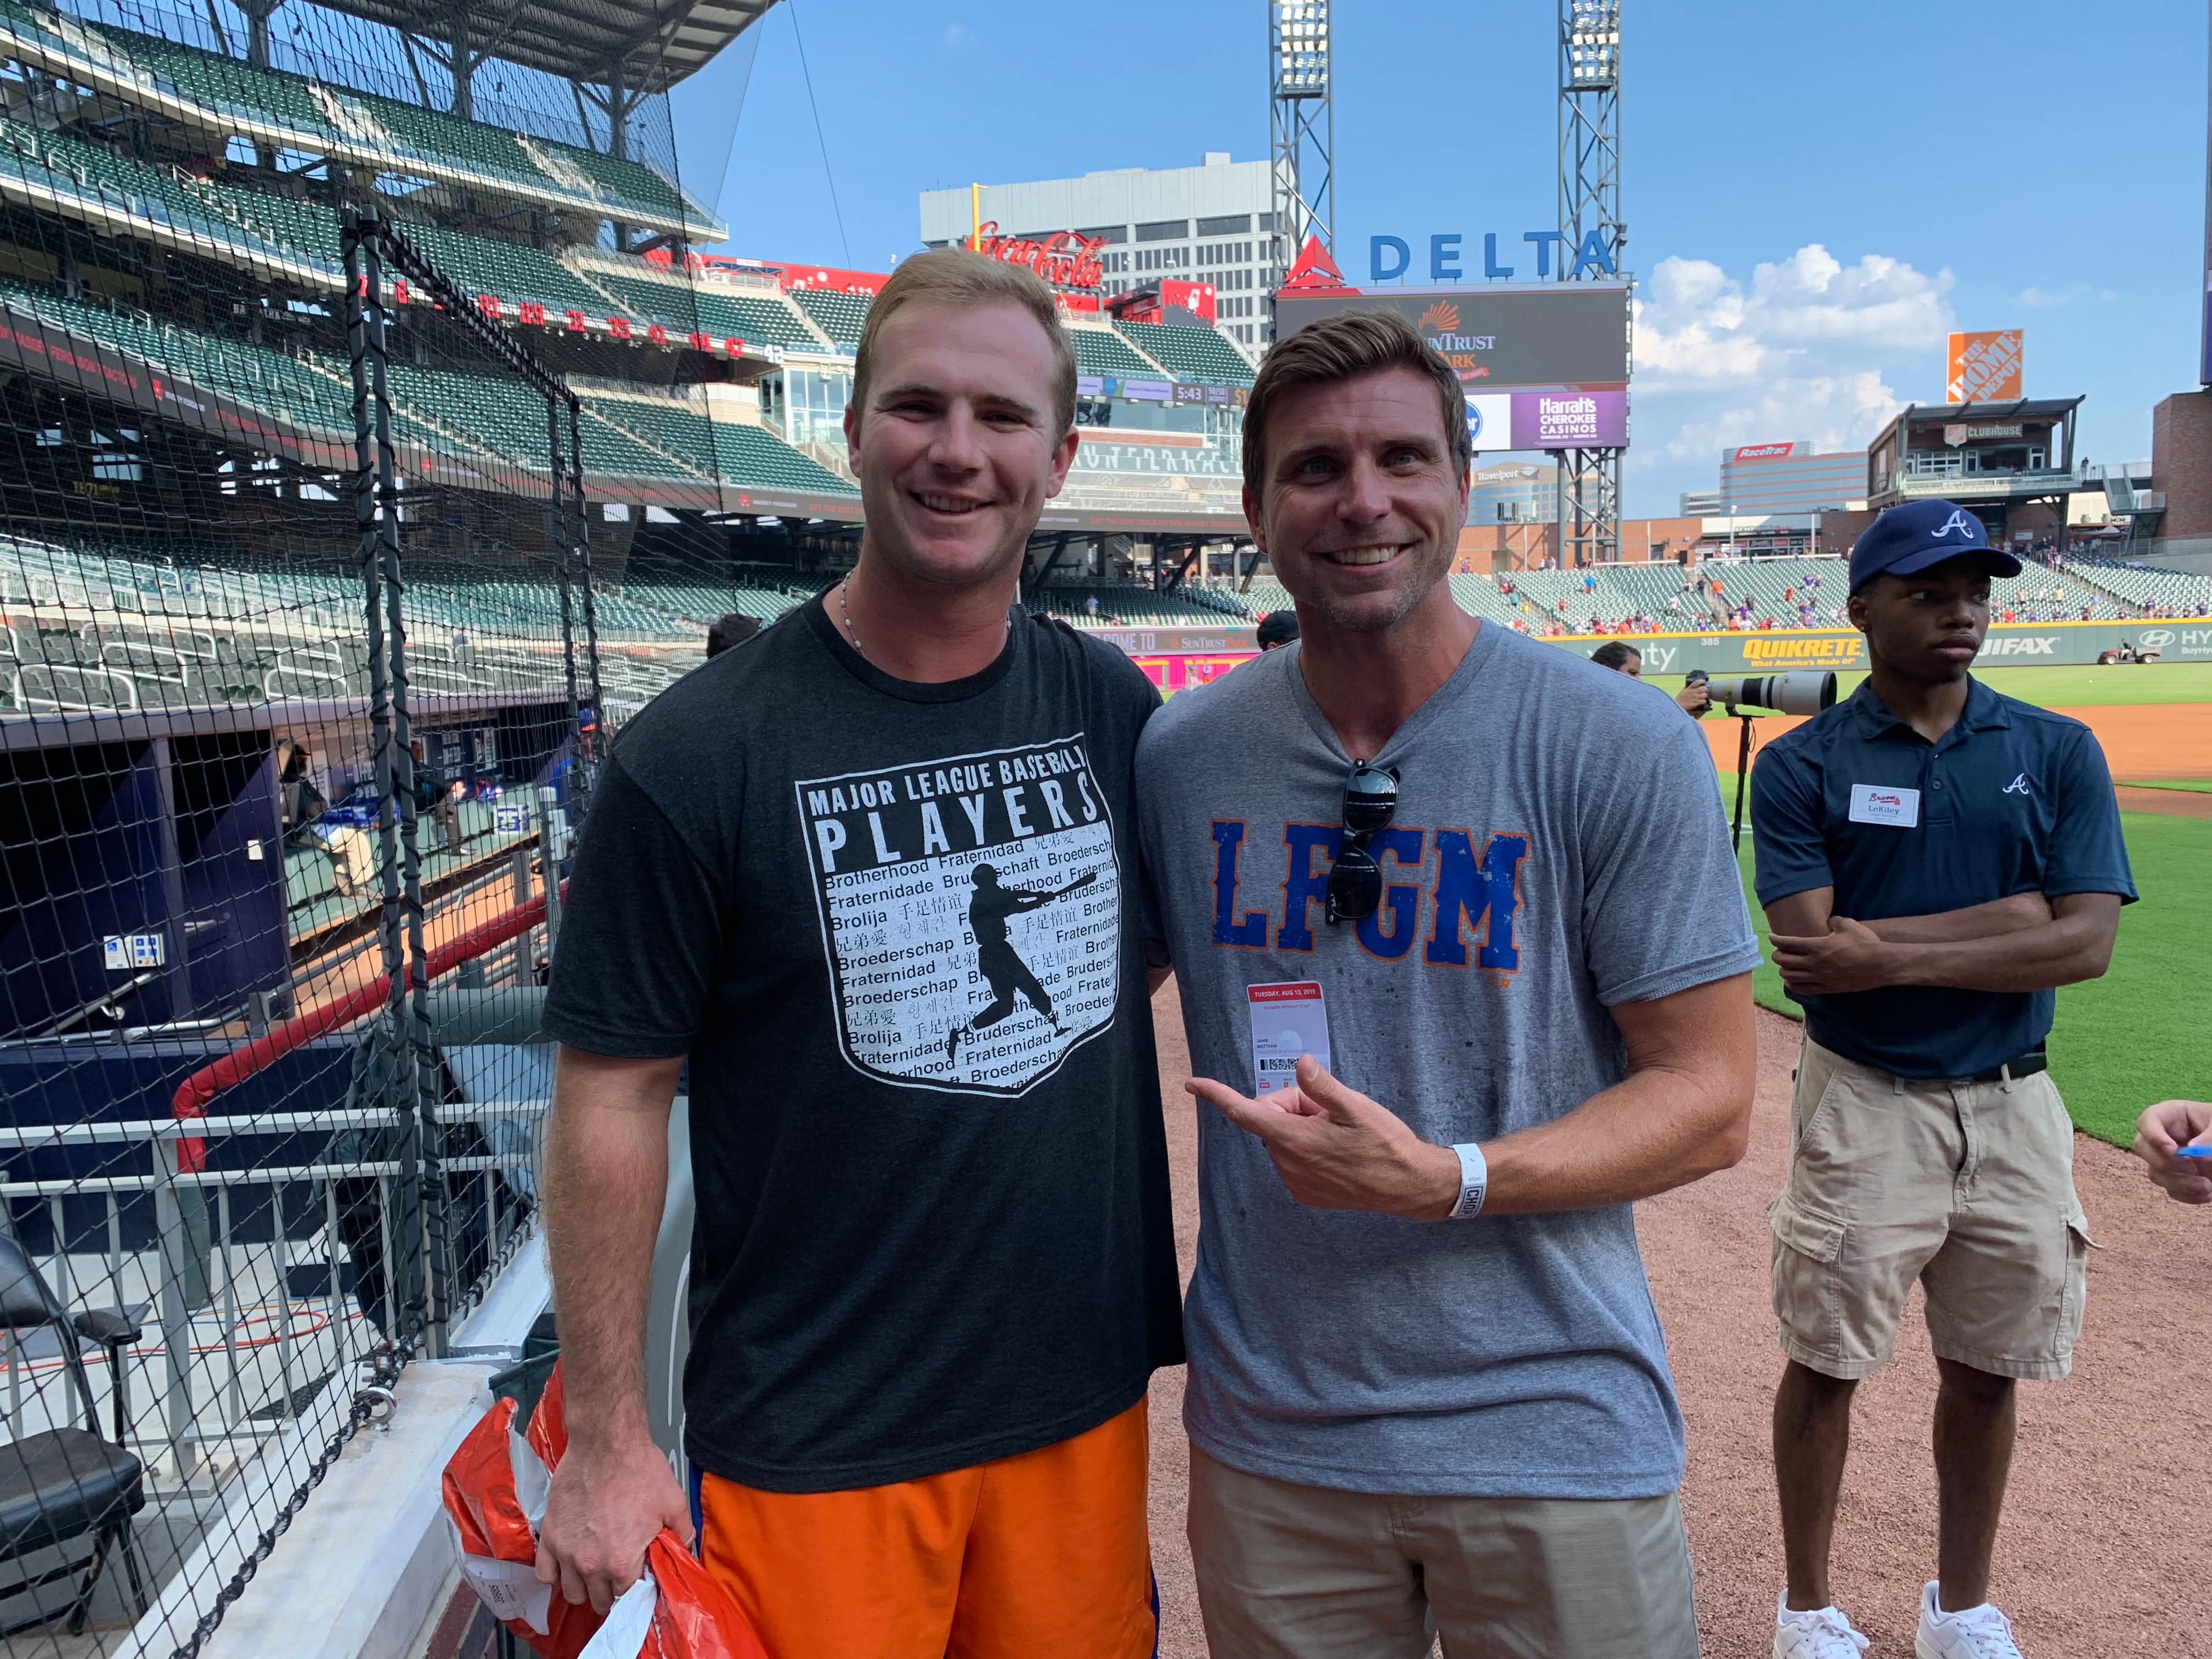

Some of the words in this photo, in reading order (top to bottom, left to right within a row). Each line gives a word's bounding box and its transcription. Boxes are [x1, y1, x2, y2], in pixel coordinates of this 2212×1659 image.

[1370, 230, 1616, 279] DELTA
[520, 302, 545, 325] 29
[607, 316, 630, 339] 35
[724, 337, 745, 357] 47
[764, 344, 783, 363] 42
[1955, 339, 1986, 366] THE
[1948, 331, 2021, 402] HOME
[1976, 356, 2022, 401] DEPOT
[1177, 386, 1201, 400] 5:43
[1540, 397, 1596, 414] Harrah's
[1540, 414, 1597, 425] CHEROKEE
[1540, 425, 1596, 435] CASINOS
[1968, 425, 2021, 437] CLUBHOUSE
[1740, 446, 1787, 458] RaceTrac
[1477, 470, 1519, 481] Travelport
[1138, 633, 1155, 650] TO
[1701, 637, 1719, 646] 385
[808, 781, 896, 816] MAJOR
[904, 763, 994, 800] LEAGUE
[1869, 793, 1895, 802] Braves
[1869, 805, 1900, 815] LeKiley
[815, 771, 1097, 873] PLAYERS
[825, 859, 929, 890] Brotherhood
[939, 840, 1024, 869] Fraternidad
[827, 880, 934, 909] Fraternidade
[1047, 839, 1113, 866] Broedersch
[1210, 819, 1532, 974] LFGM
[832, 910, 888, 931] Brolija
[838, 939, 954, 971] Broederschap
[842, 960, 936, 988] Fraternidad
[1056, 914, 1119, 944] Fraternidade
[844, 978, 958, 1008] Broederschap
[850, 1030, 902, 1047] Brolija
[966, 1031, 1051, 1065] Fraternidad
[1461, 1189, 1480, 1215] CHOP
